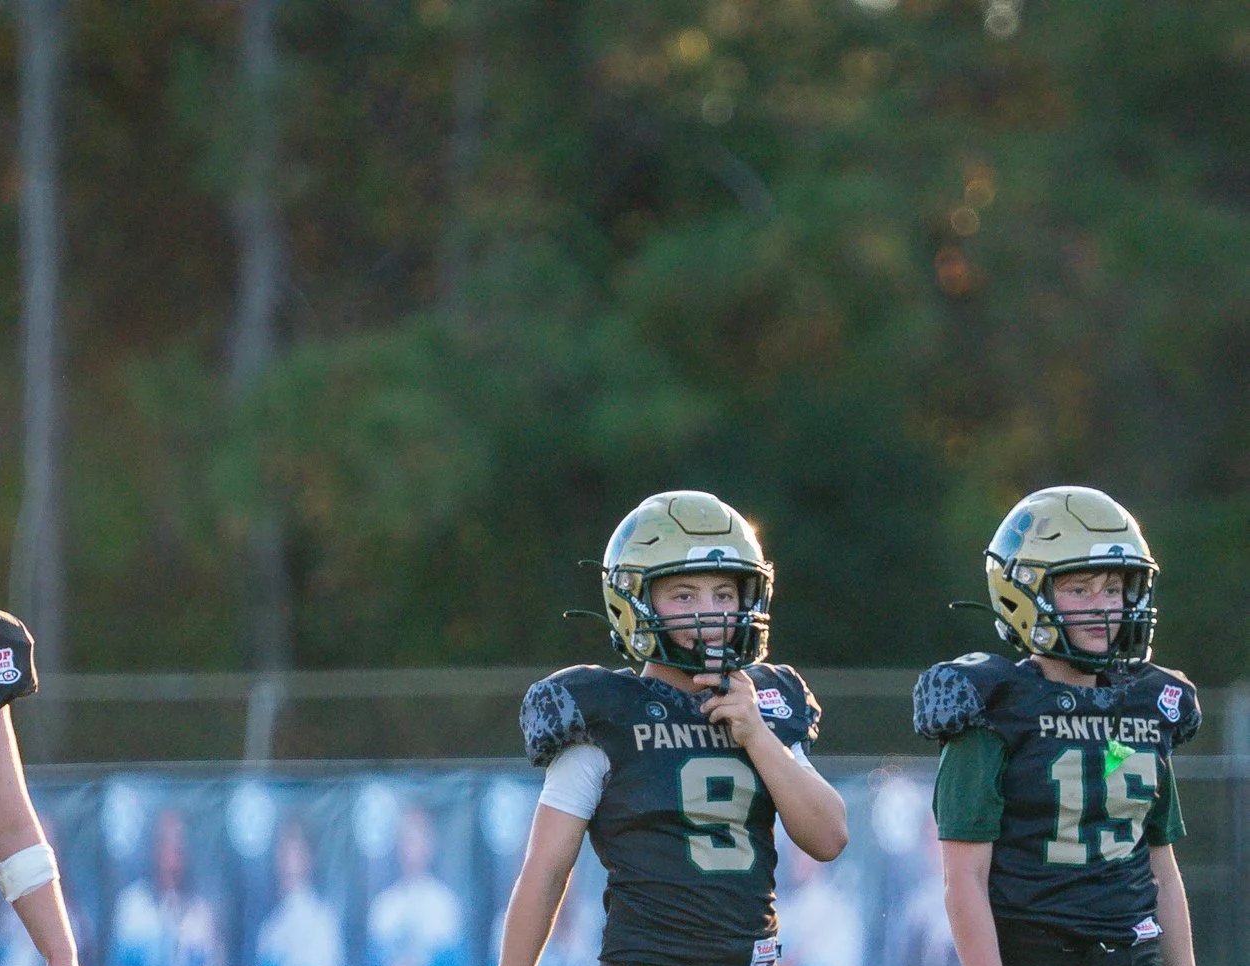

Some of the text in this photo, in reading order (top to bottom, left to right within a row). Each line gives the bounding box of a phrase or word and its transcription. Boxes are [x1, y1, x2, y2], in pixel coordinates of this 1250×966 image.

[758, 691, 778, 699] POP
[633, 722, 776, 750] PANTH
[680, 753, 757, 875] 9
[1042, 746, 1157, 867] 15
